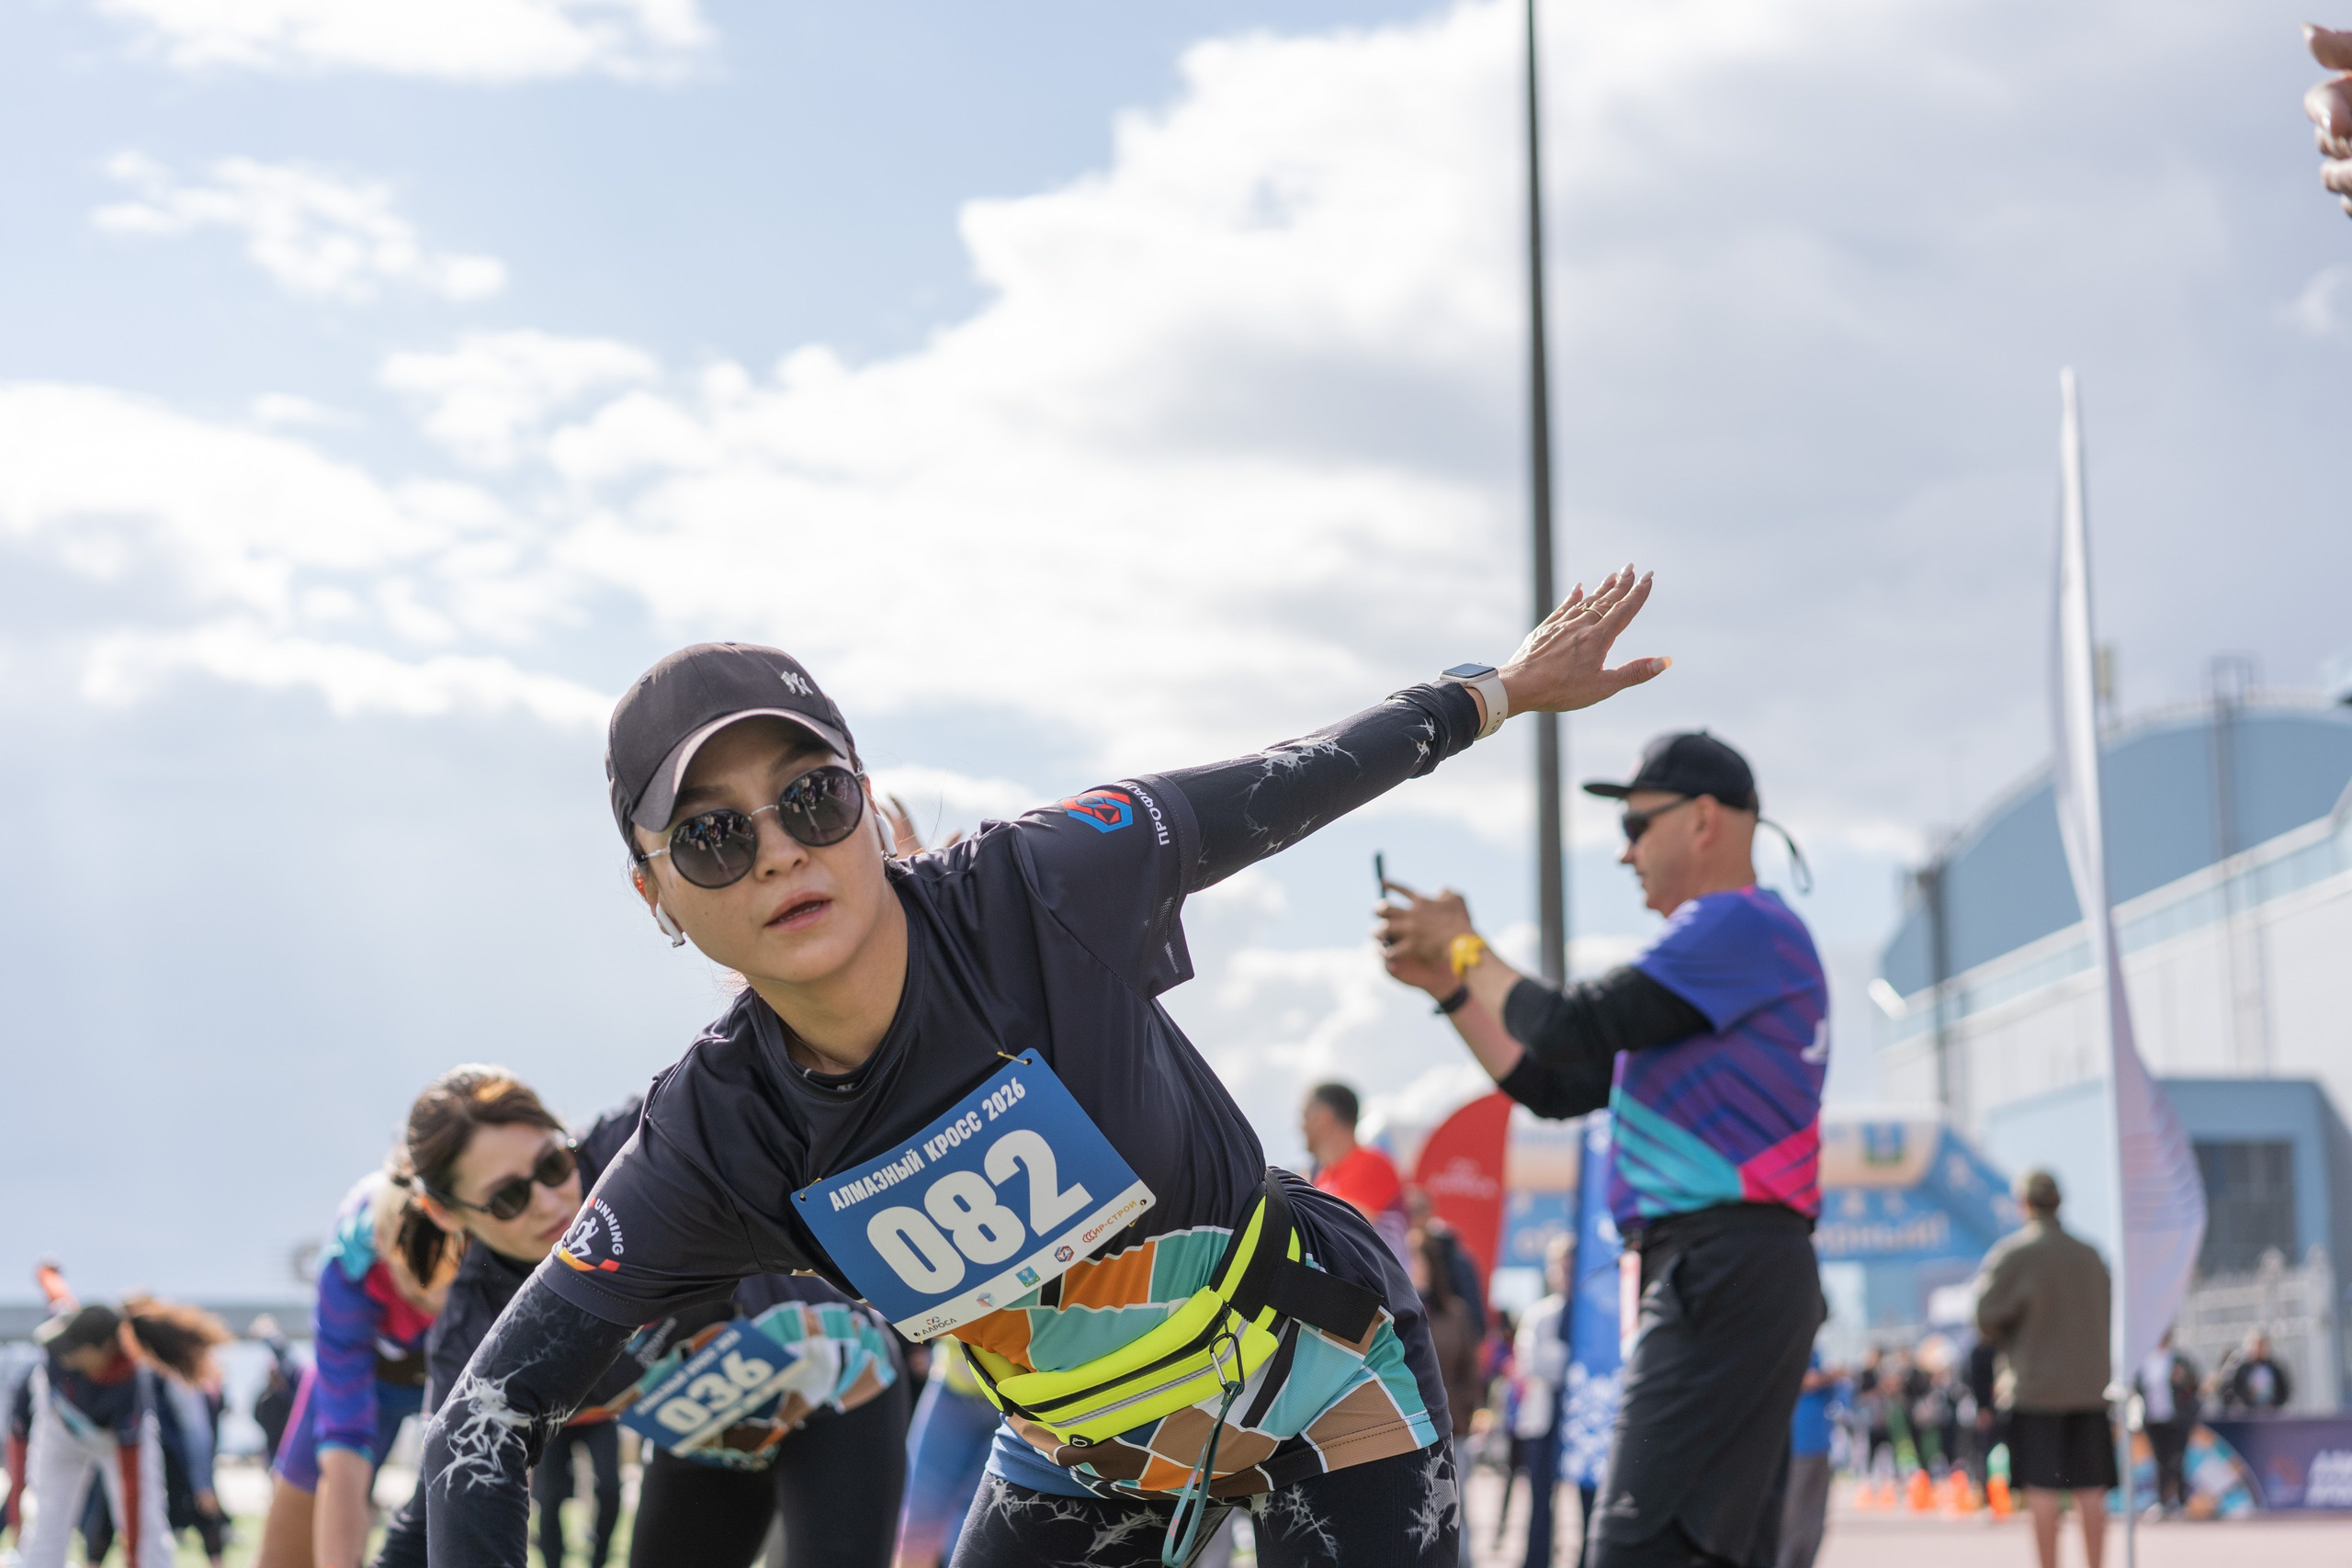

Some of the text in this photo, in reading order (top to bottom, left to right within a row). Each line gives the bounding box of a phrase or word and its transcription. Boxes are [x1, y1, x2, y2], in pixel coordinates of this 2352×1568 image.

[829, 1077, 1026, 1212] АЛМАЗНЫЙ КРОСС 2026
[866, 1129, 1093, 1294] 082
[654, 1349, 775, 1435] 036
